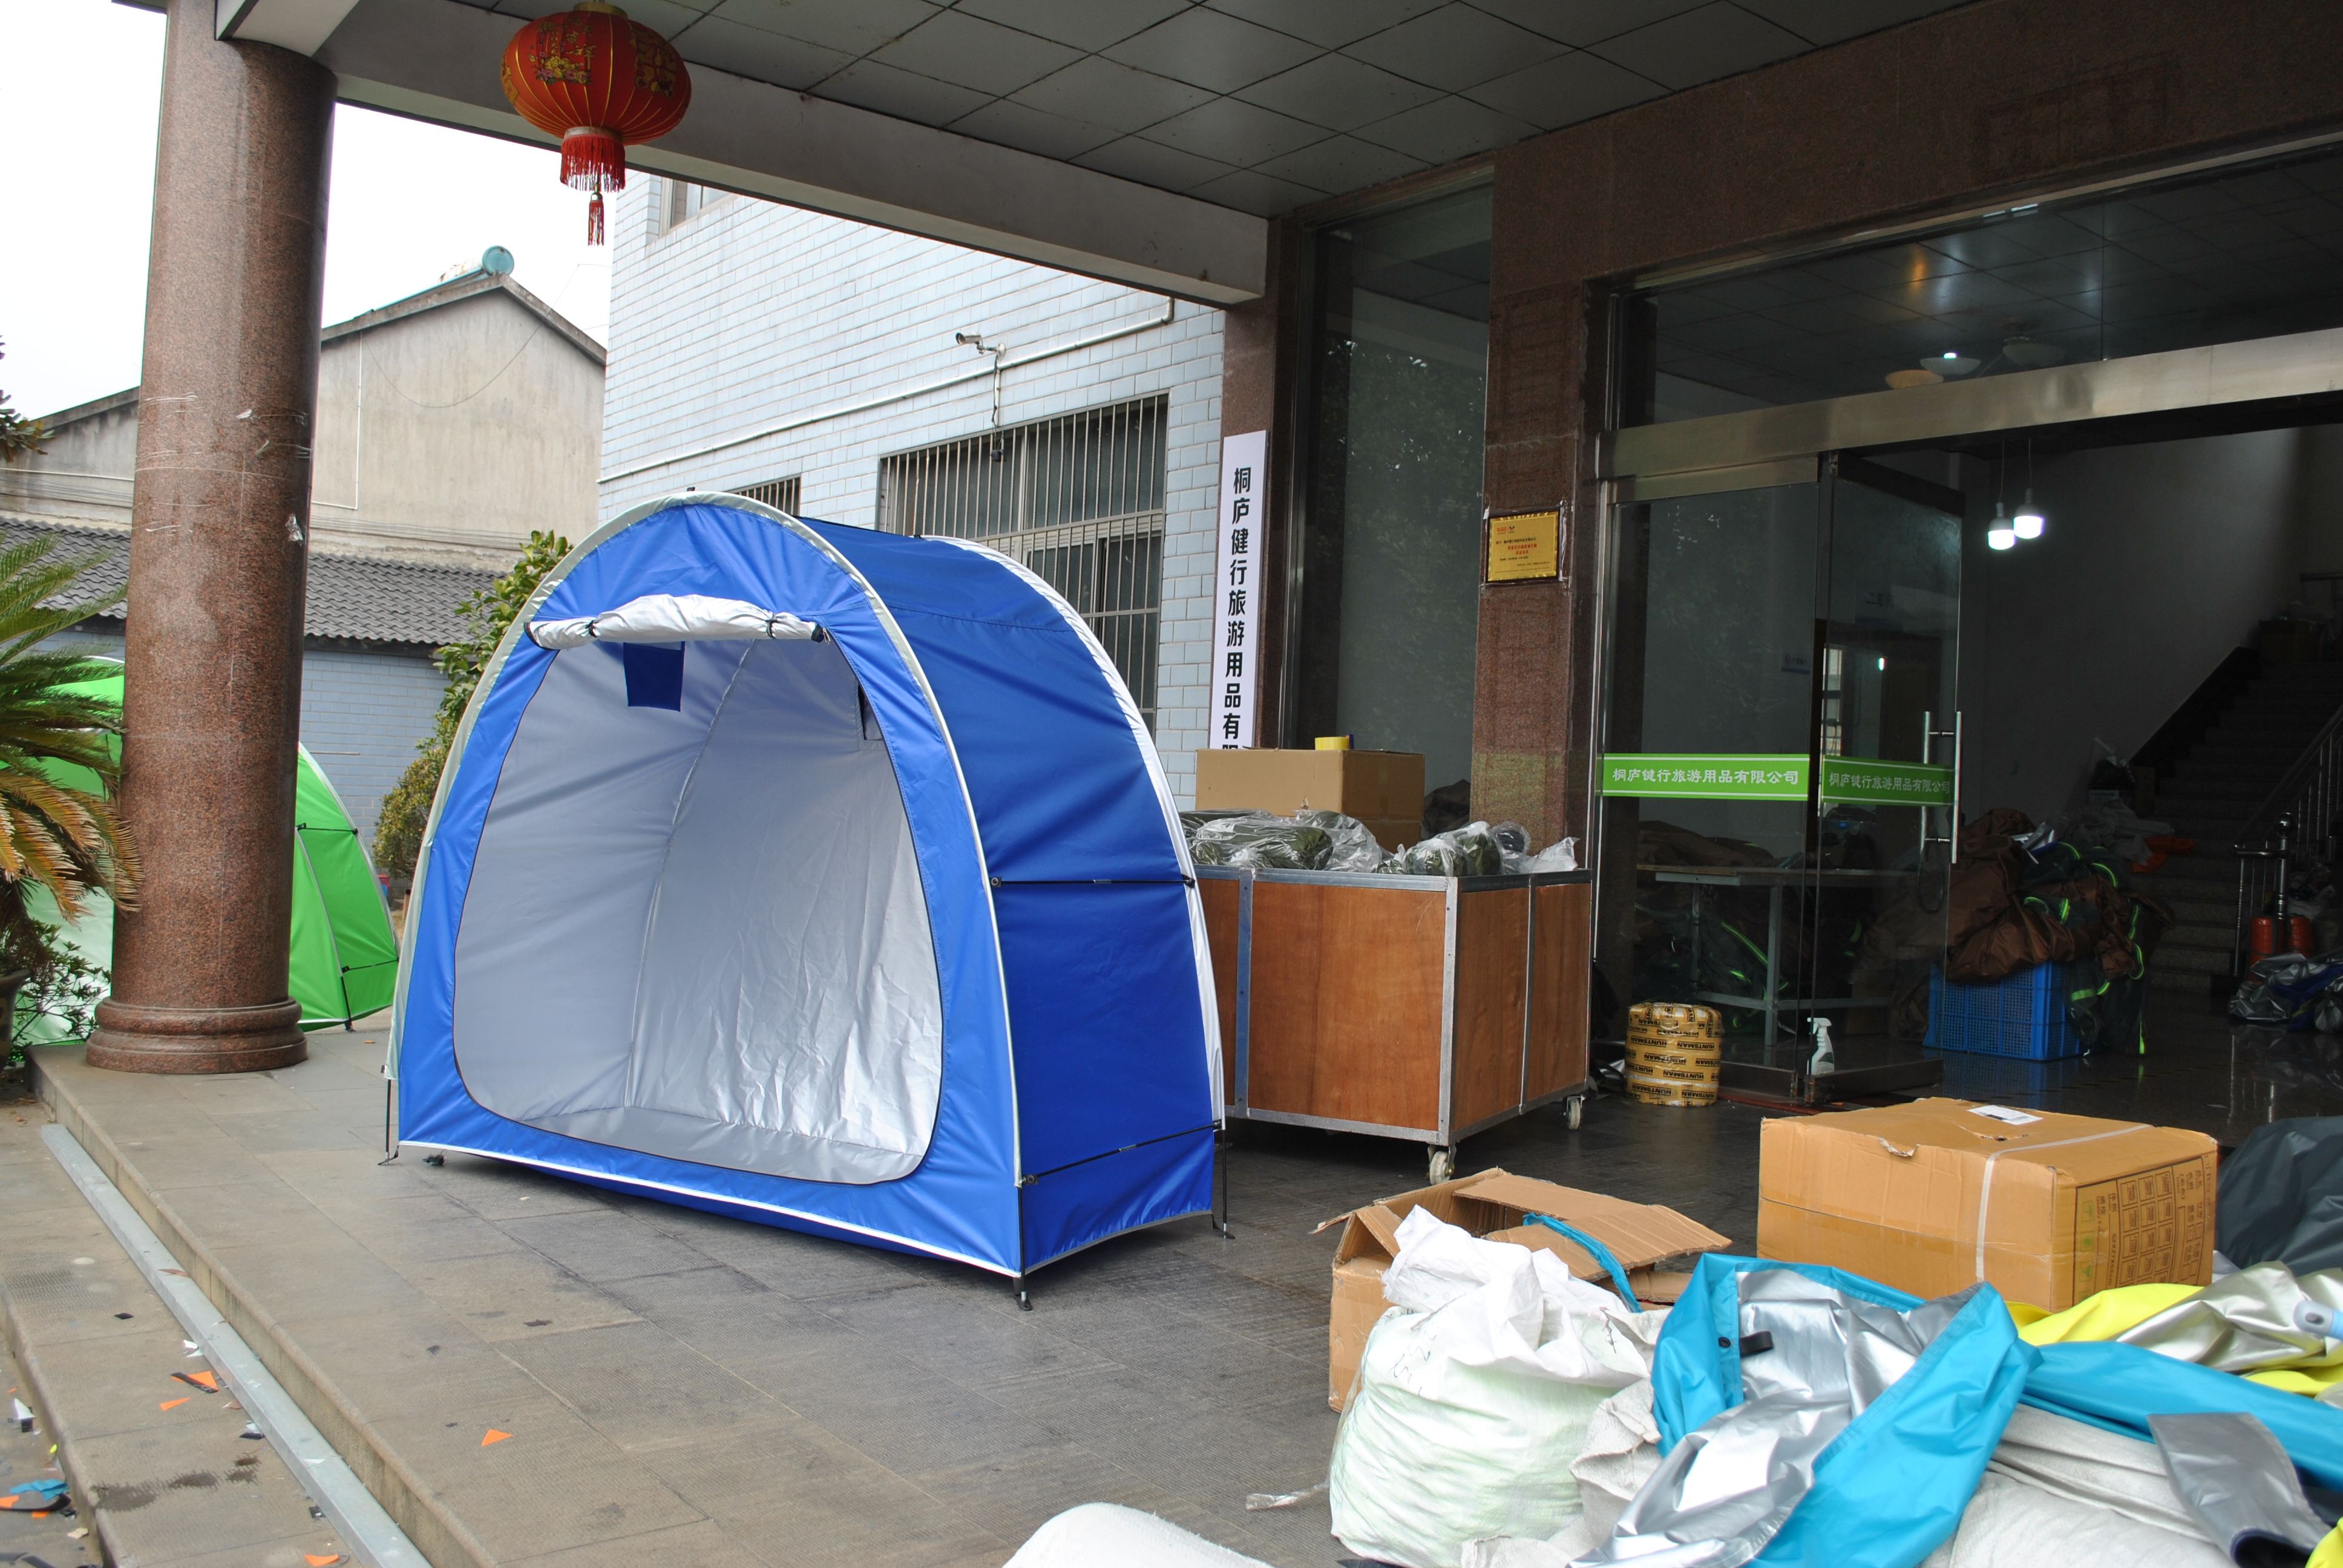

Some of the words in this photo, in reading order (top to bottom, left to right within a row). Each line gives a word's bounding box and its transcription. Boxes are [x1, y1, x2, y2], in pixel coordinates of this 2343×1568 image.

[1222, 467, 1251, 750] 桐庐健行旅游用品有
[1644, 1054, 1686, 1063] HUNTSMAN
[1663, 1069, 1703, 1079] HUNTSMAN
[1633, 1085, 1671, 1094] HUNTSMAN
